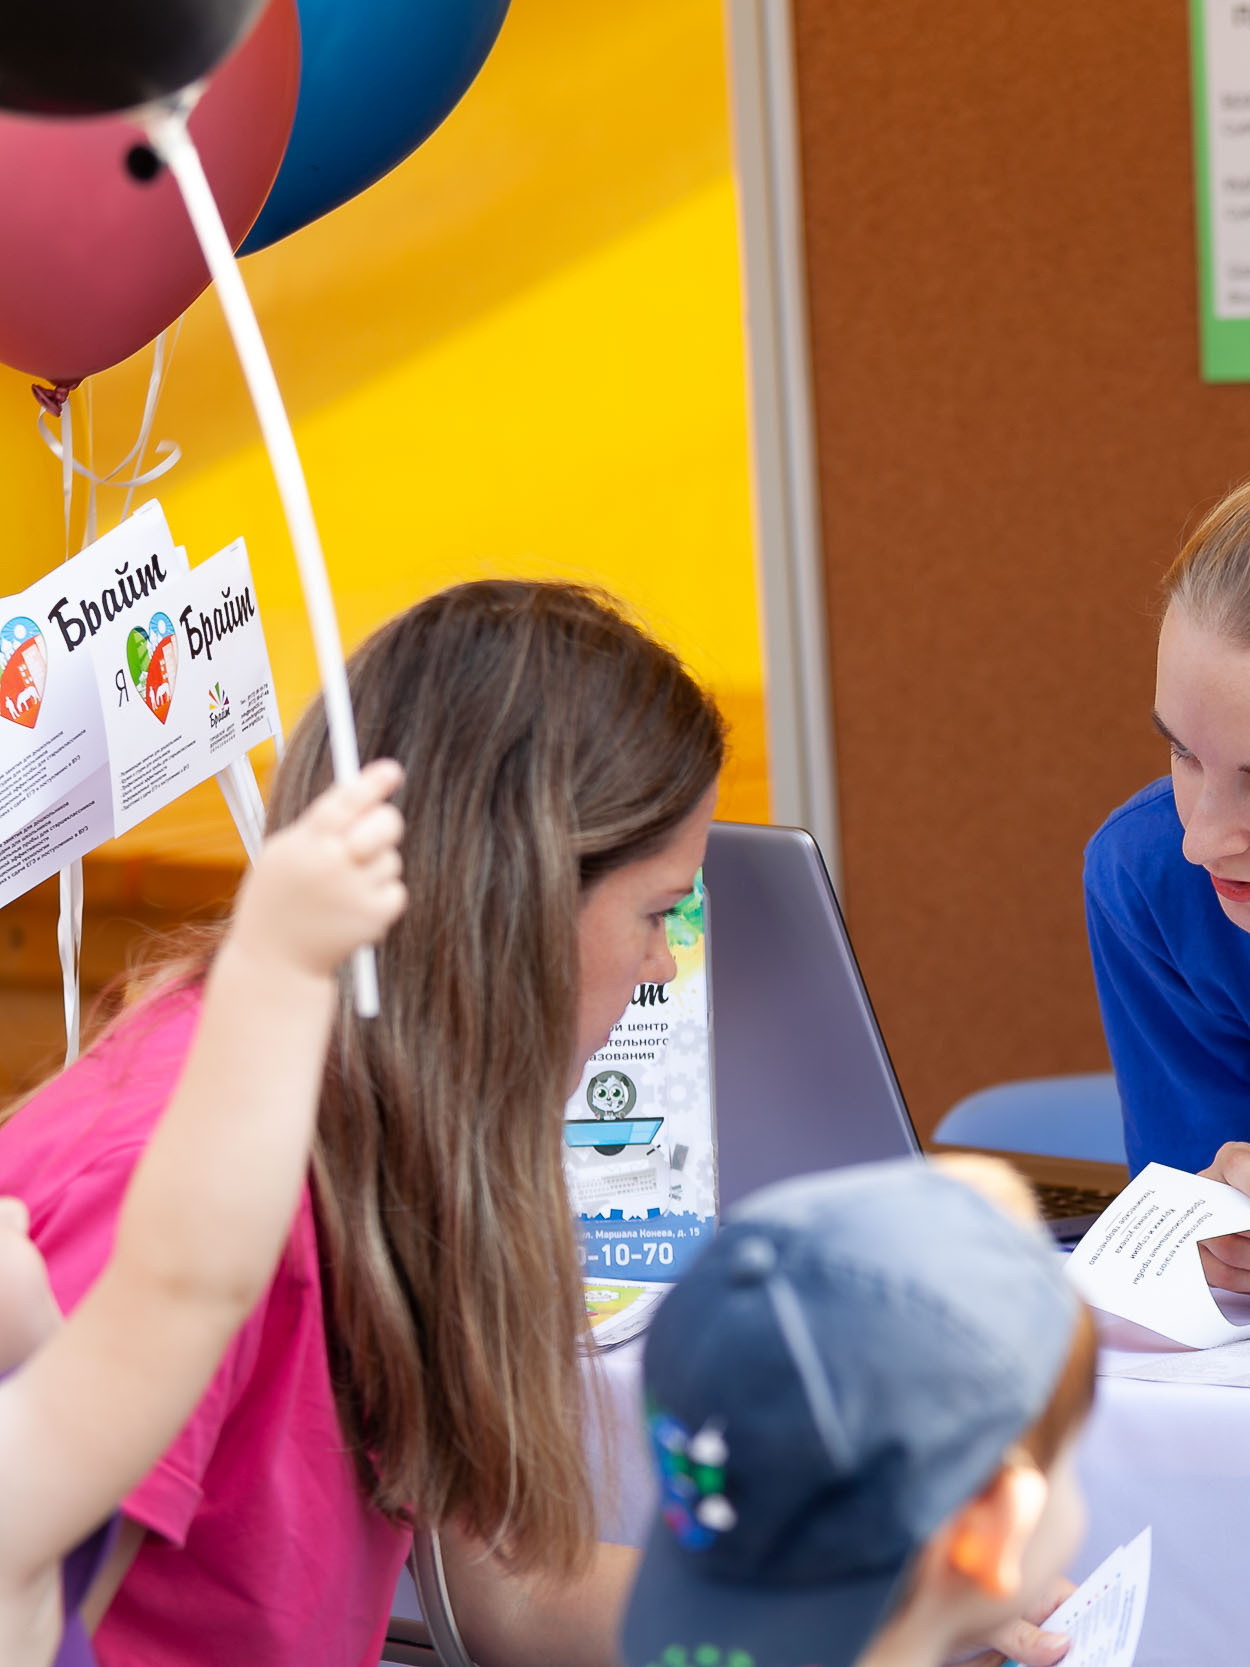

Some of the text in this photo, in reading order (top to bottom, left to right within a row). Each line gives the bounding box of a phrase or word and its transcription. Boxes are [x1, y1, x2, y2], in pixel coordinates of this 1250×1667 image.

[48, 554, 167, 652] Брайт
[179, 586, 255, 660] Брайт
[115, 668, 130, 708] Я
[21, 823, 33, 833] для
[32, 800, 69, 826] дошкольников
[10, 837, 21, 847] для
[24, 857, 36, 867] ЕГЭ
[77, 825, 88, 835] ВУЗ
[38, 828, 49, 837] для
[628, 1022, 669, 1033] центр
[1152, 1206, 1175, 1230] Кружки
[595, 1229, 638, 1240] Маршала
[640, 1228, 676, 1239] Конева,
[690, 1227, 700, 1237] 15
[1087, 1223, 1120, 1266] творчество
[1129, 1233, 1150, 1260] студии
[1131, 1257, 1153, 1286] пробы
